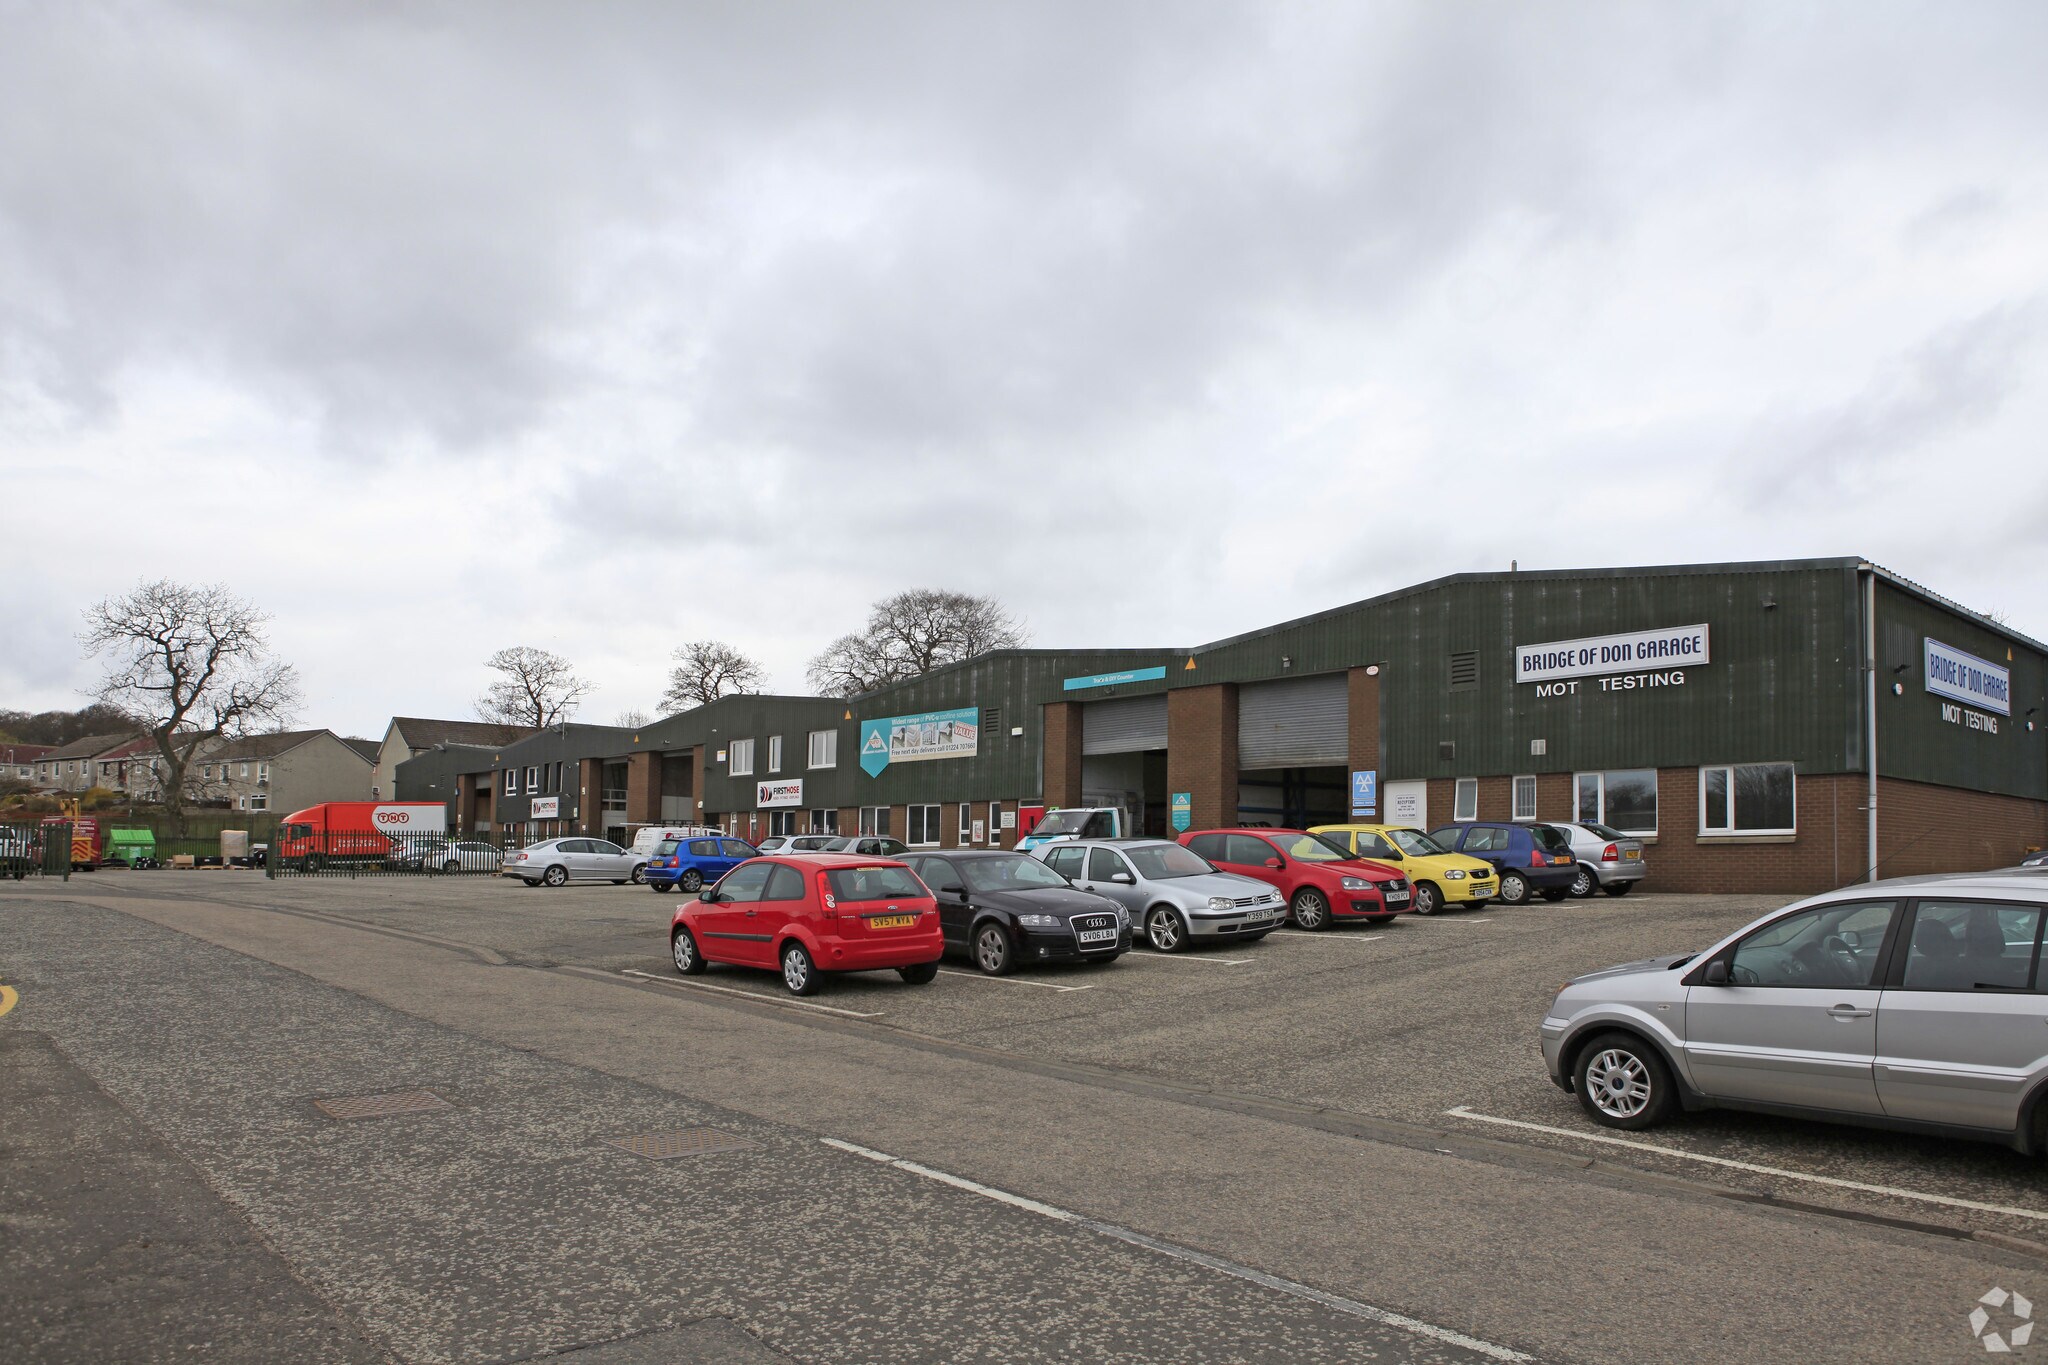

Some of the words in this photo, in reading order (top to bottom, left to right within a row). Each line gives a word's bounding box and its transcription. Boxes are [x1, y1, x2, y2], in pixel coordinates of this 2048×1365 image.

[1523, 650, 1576, 672] BRIDGE
[1578, 647, 1598, 666] OF
[1601, 643, 1632, 664] DON
[1636, 635, 1702, 660] GARAGE
[1930, 653, 1957, 685] BRIDGE
[1958, 663, 1967, 689] OF
[1968, 667, 1982, 694] DON
[1983, 672, 2008, 703] GARAGE
[1536, 681, 1578, 698] MOT
[1598, 671, 1685, 692] TESTING
[1942, 703, 1961, 725] MOT
[1964, 709, 1998, 734] TESTING
[954, 726, 976, 740] VALUE
[920, 746, 937, 754] delivery
[773, 785, 800, 795] FIRSTHOSE
[379, 813, 408, 822] TNT
[1247, 911, 1263, 921] Y359
[1263, 910, 1273, 919] TSA
[874, 917, 895, 928] SV57
[896, 916, 911, 926] WYA
[1083, 931, 1101, 941] SV06
[1101, 930, 1115, 939] LBA
